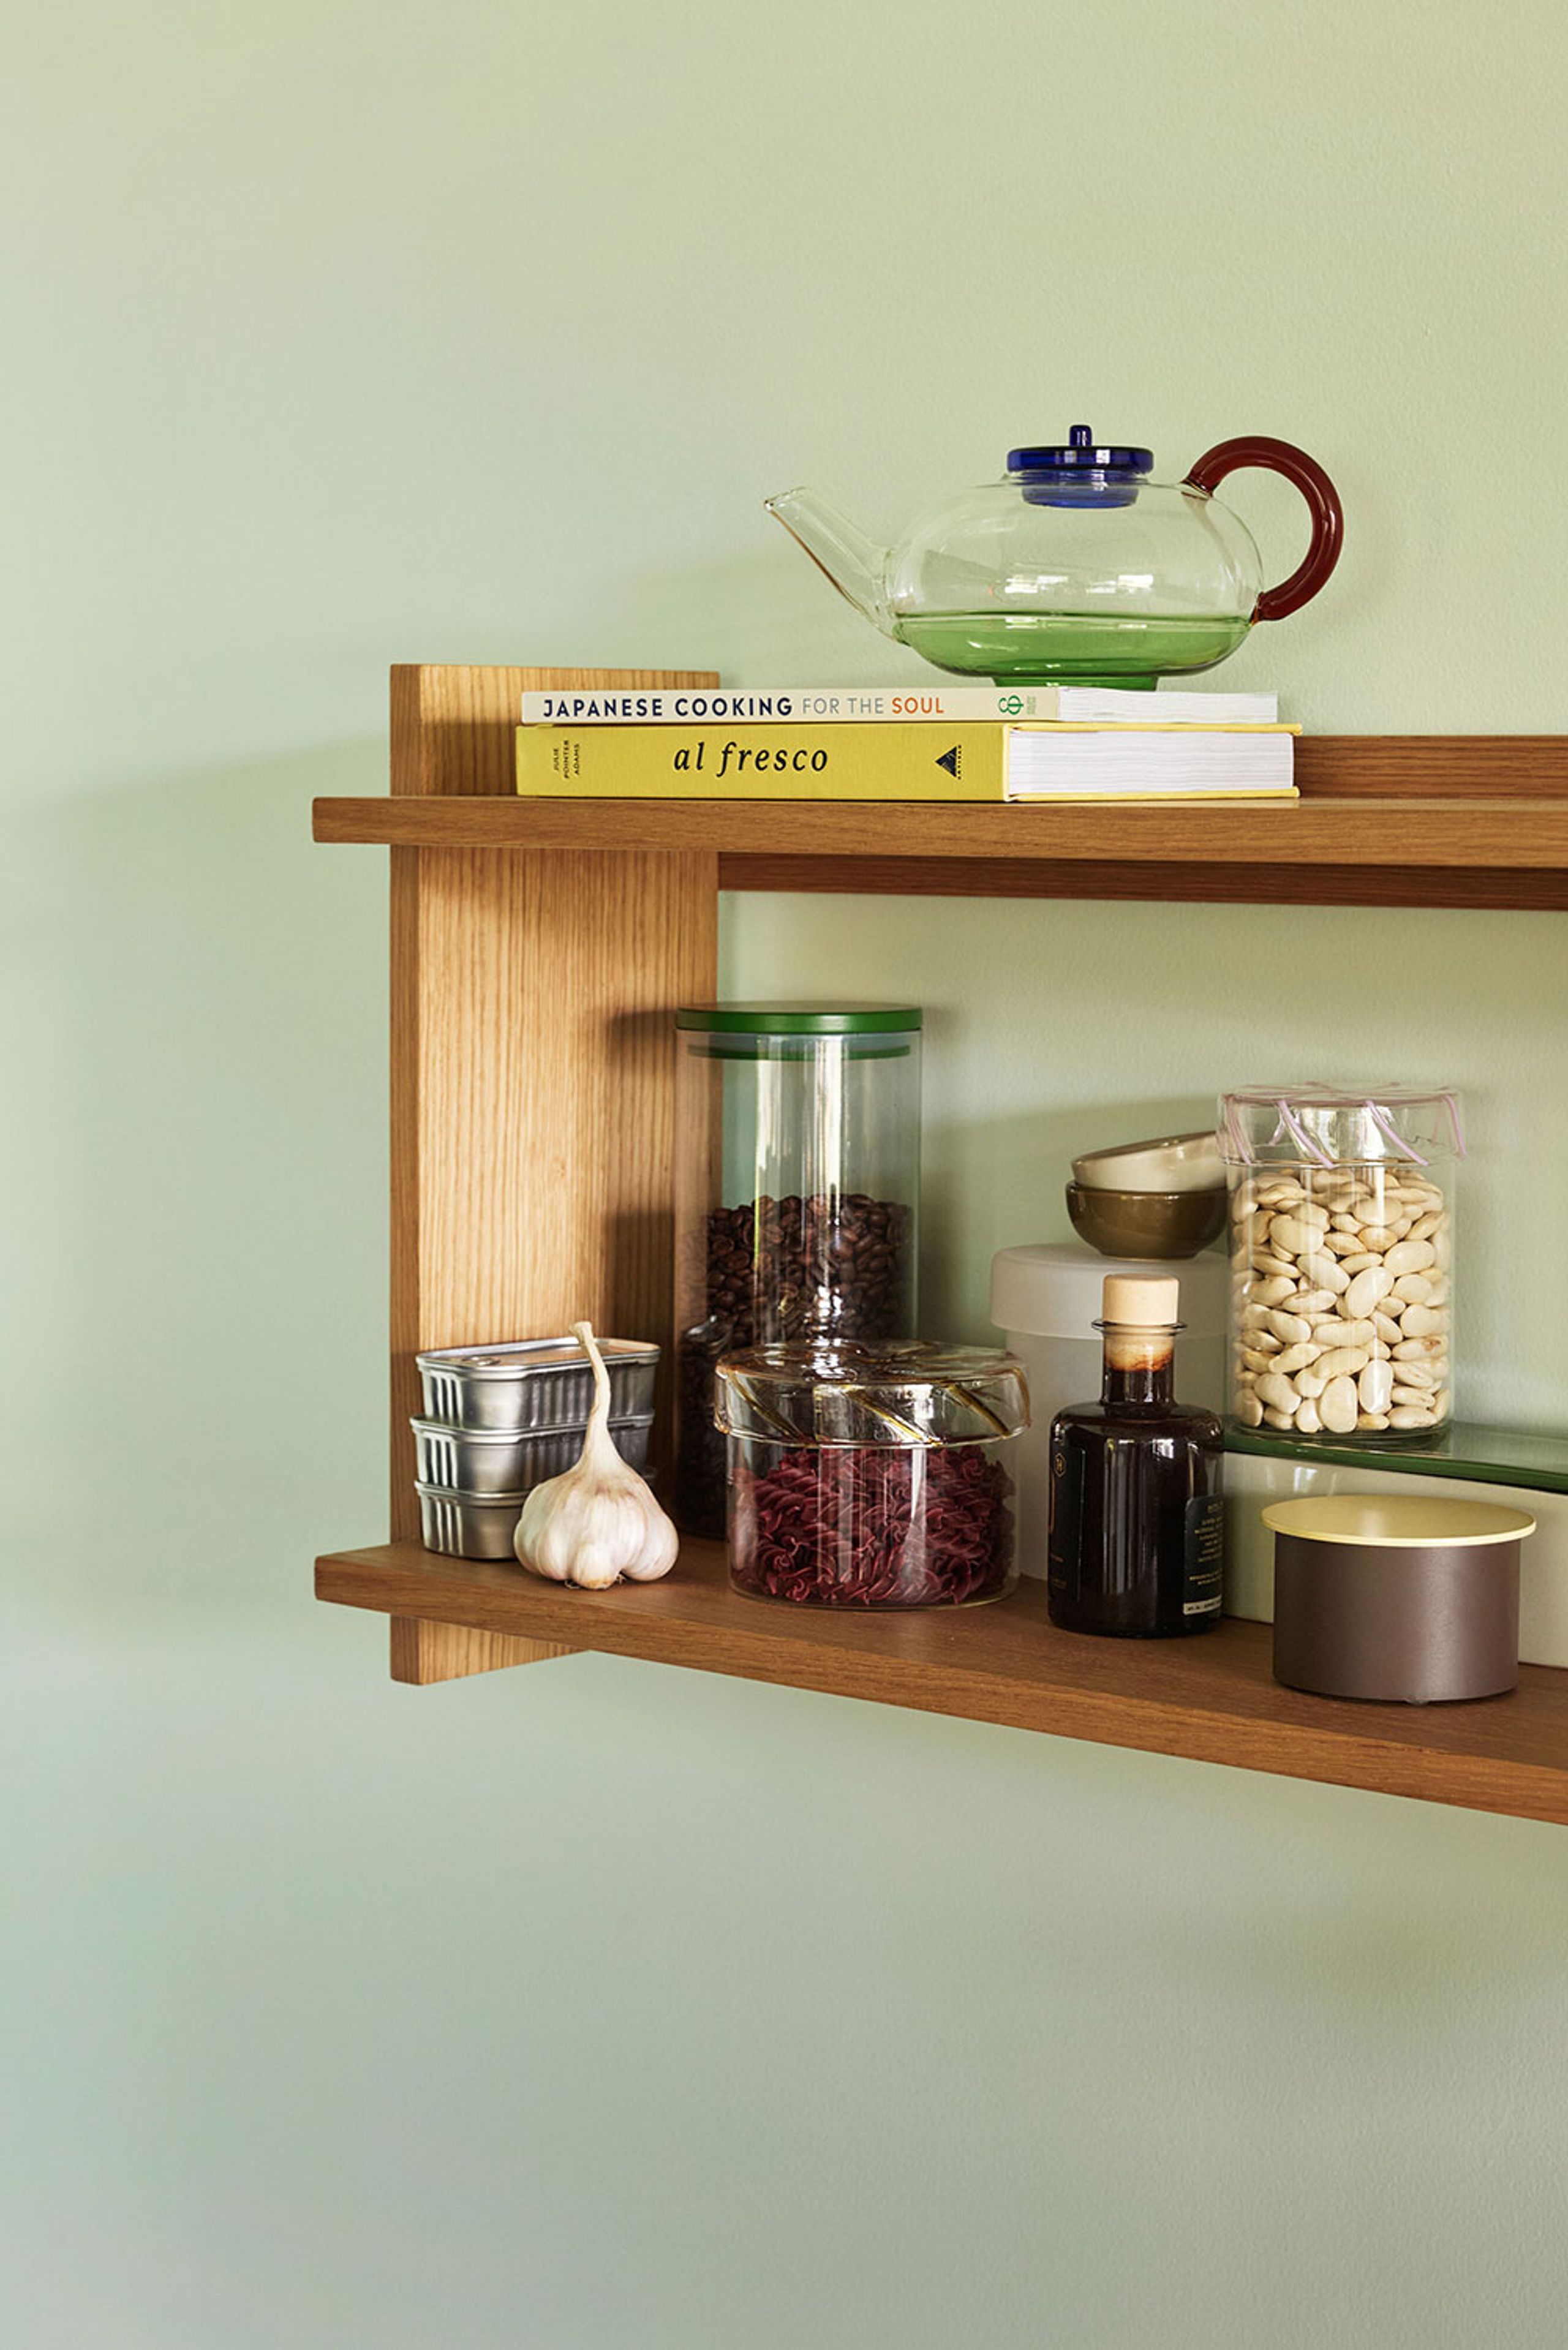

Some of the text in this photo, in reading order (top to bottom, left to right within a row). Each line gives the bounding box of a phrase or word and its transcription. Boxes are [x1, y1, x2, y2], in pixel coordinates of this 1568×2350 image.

[543, 697, 944, 717] JAPANESE COOKING FOR THE SOUL
[674, 741, 828, 778] al fresco
